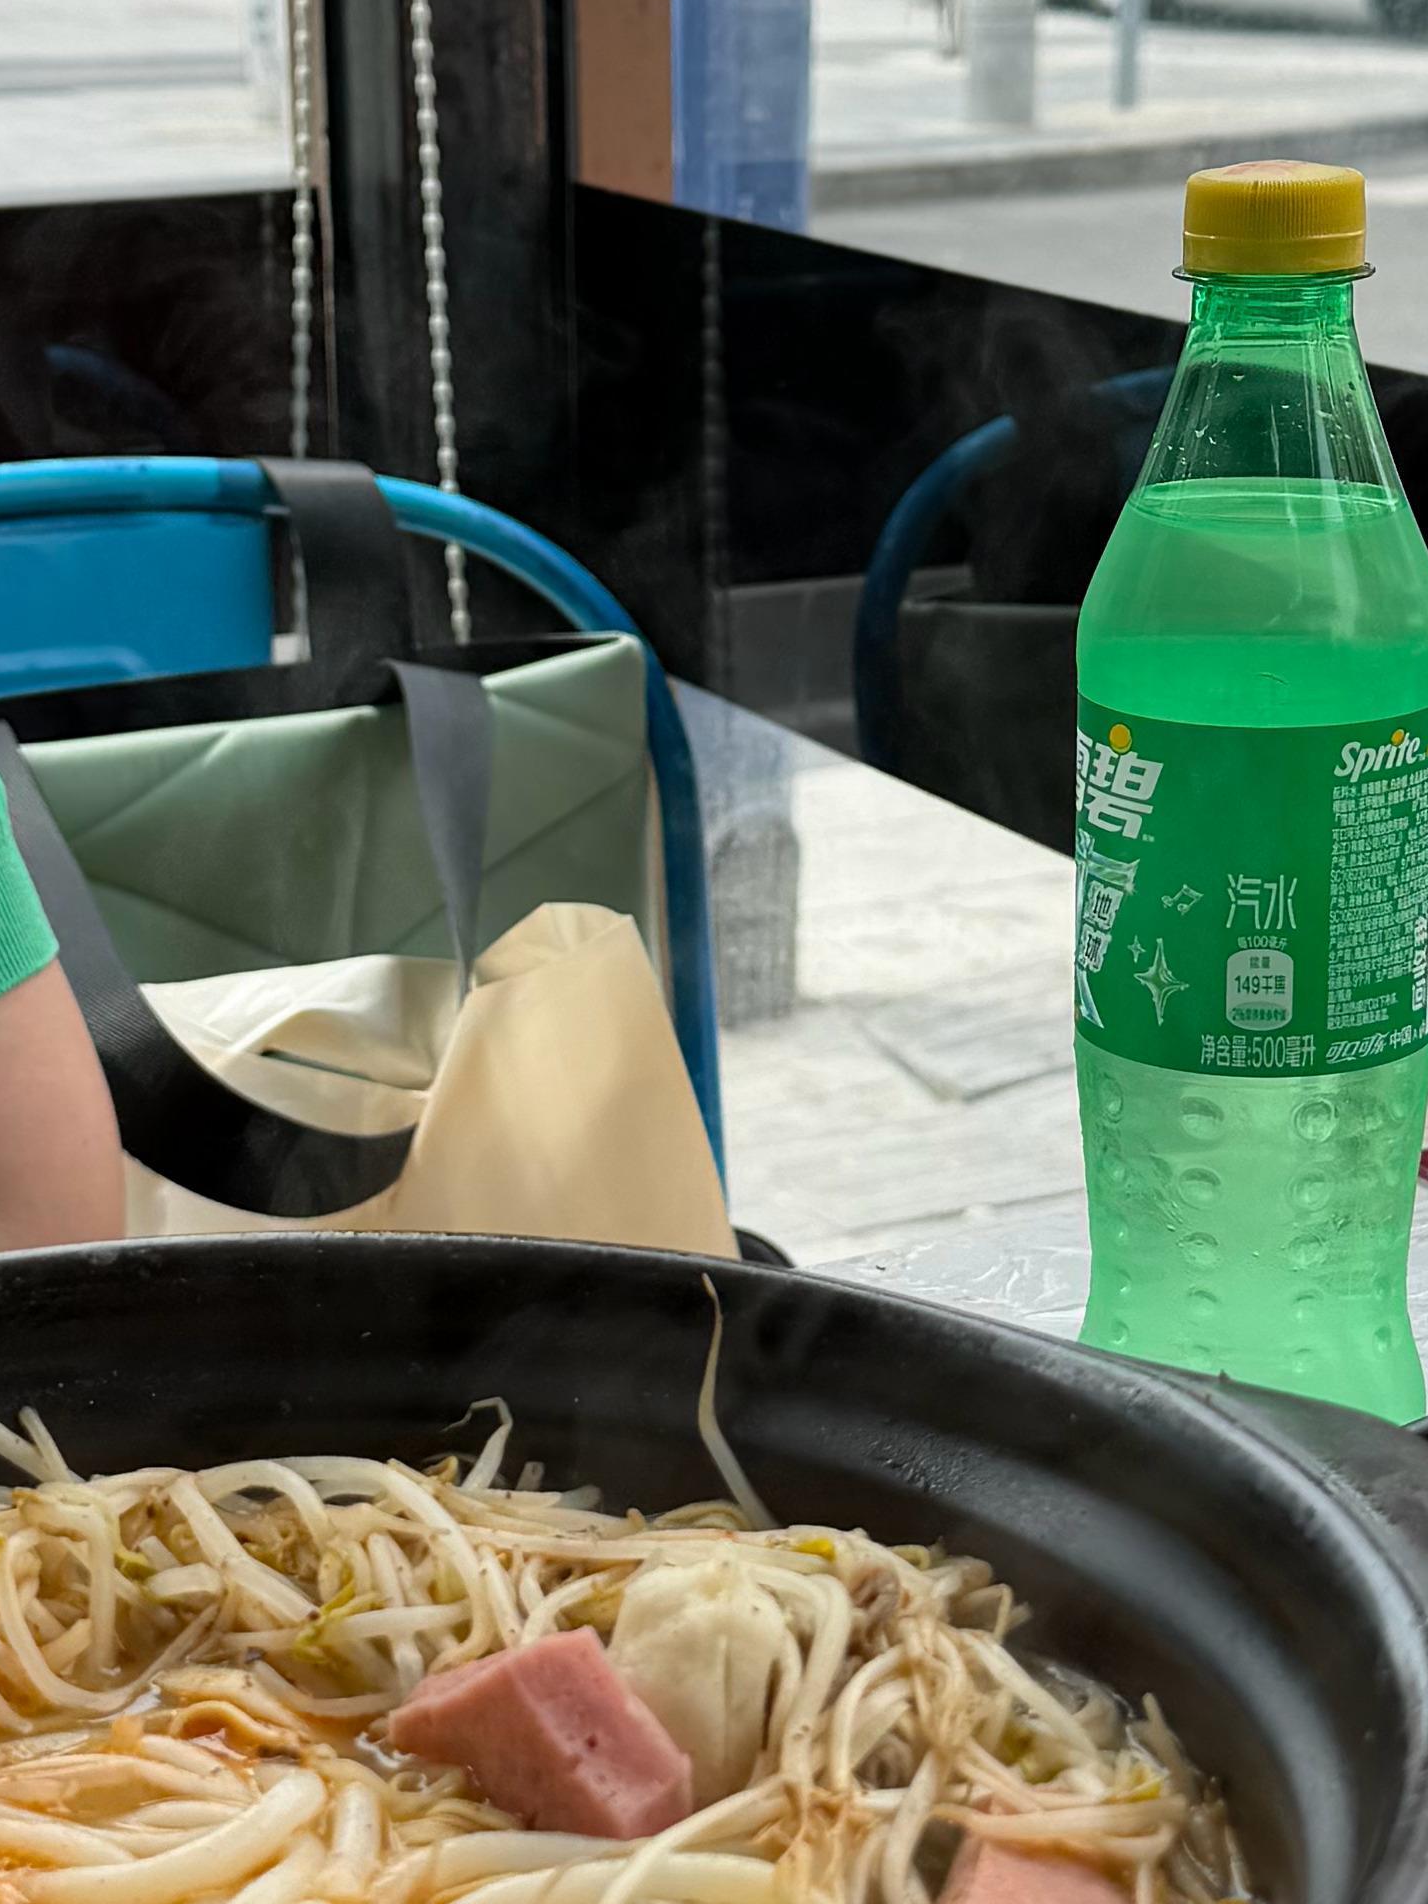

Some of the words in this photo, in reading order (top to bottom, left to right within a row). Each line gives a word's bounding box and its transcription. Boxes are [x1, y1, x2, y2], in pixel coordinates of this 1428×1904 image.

[1334, 731, 1421, 783] Sprite
[1226, 873, 1298, 930] 汽水
[1084, 890, 1112, 966] 地球
[1201, 1034, 1316, 1068] 净含量:500毫升
[1326, 1032, 1390, 1065] 可口可乐
